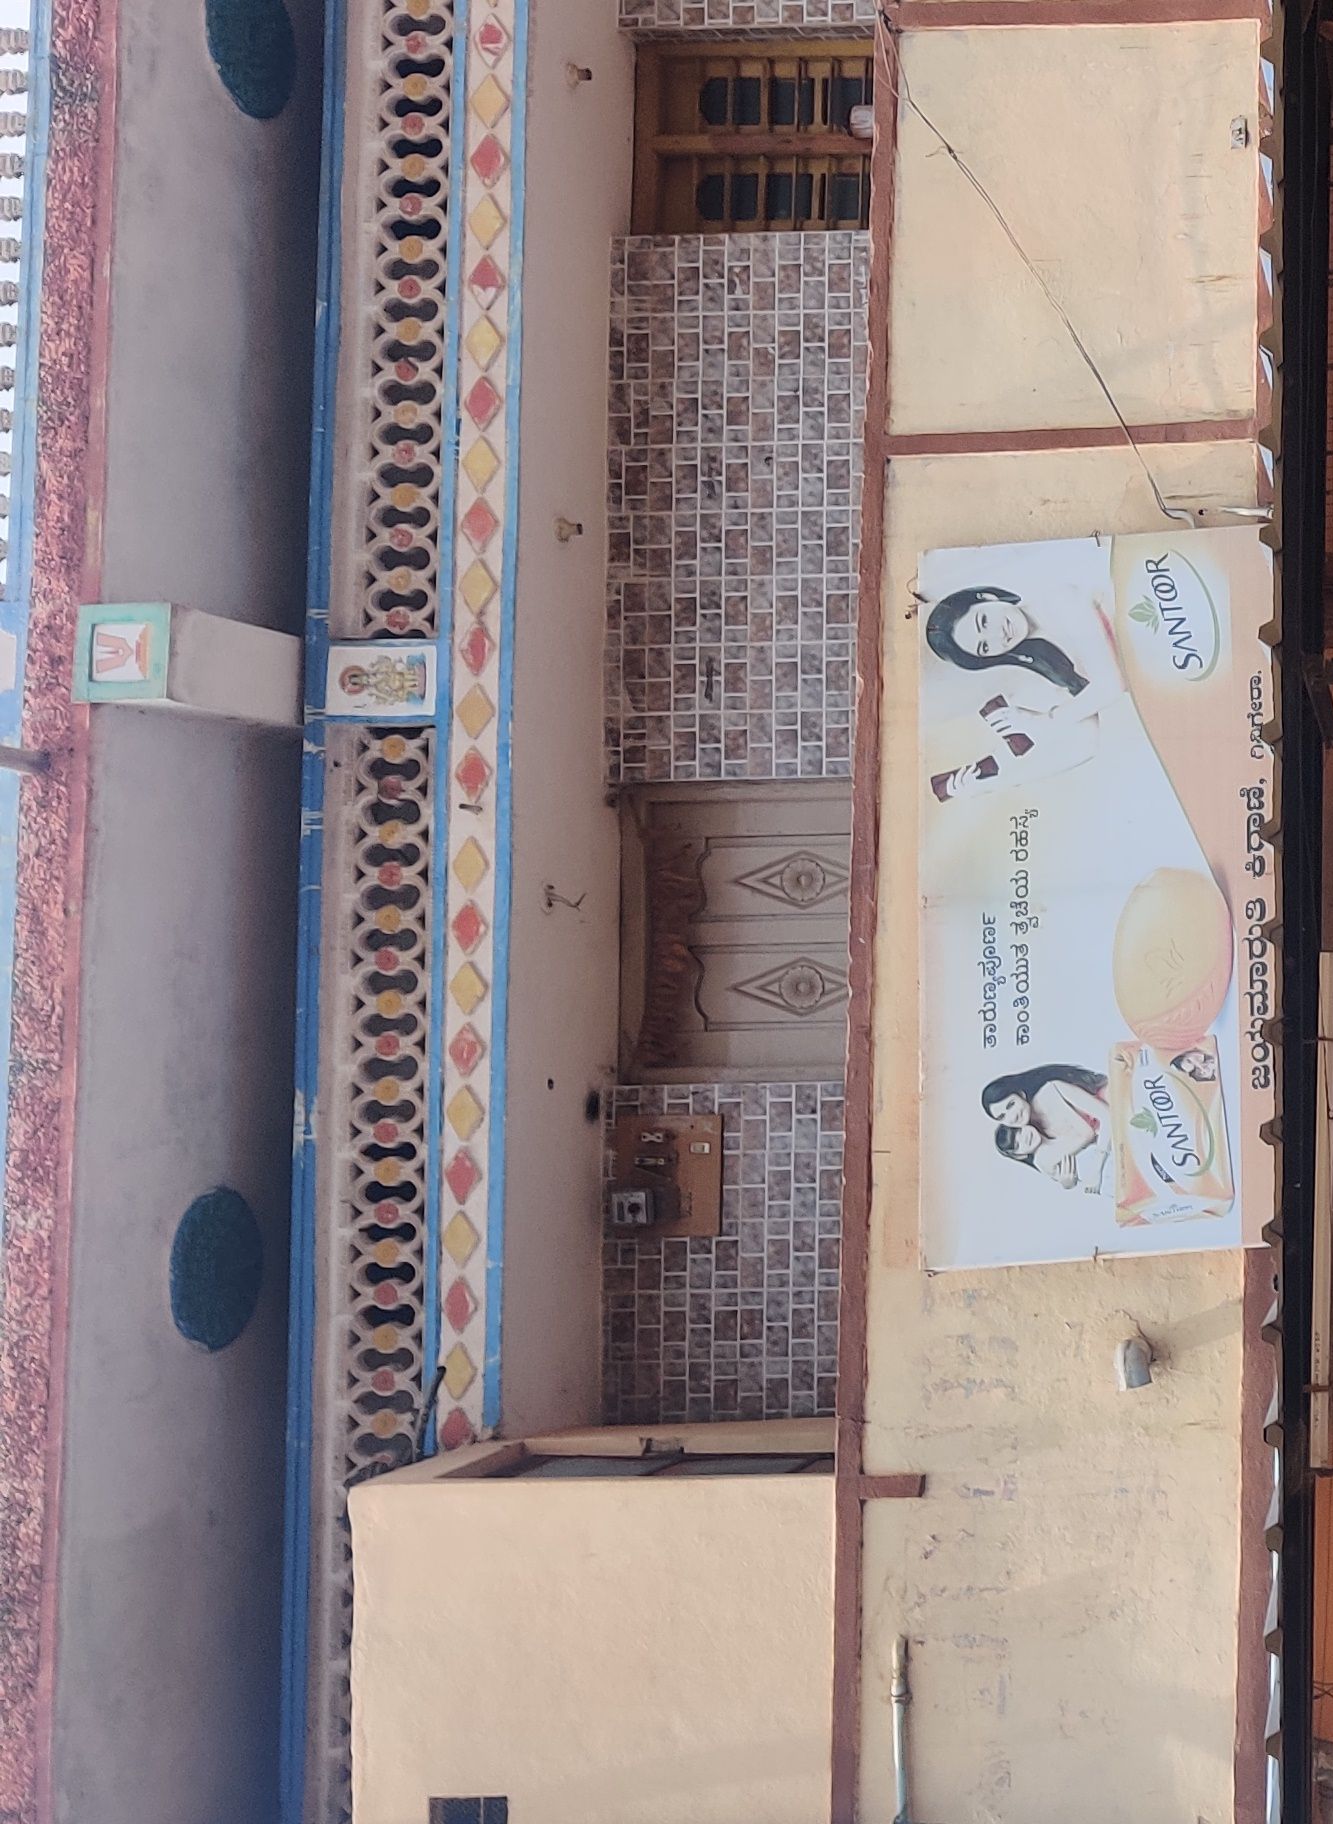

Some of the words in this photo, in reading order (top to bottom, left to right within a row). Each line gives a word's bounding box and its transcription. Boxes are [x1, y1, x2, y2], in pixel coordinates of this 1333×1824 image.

[1145, 552, 1203, 670] SANTOOR
[1009, 808, 1039, 862] ರಹಸ್ಯ
[1009, 869, 1039, 936] ತ್ವಚೆಯ
[977, 911, 1006, 1049] ತಾರುಣ್ಯಪೂರ್ಣ
[1009, 943, 1031, 1046] ಕಾಂತಿಯುತ
[1143, 1074, 1200, 1167] SANTOOR
